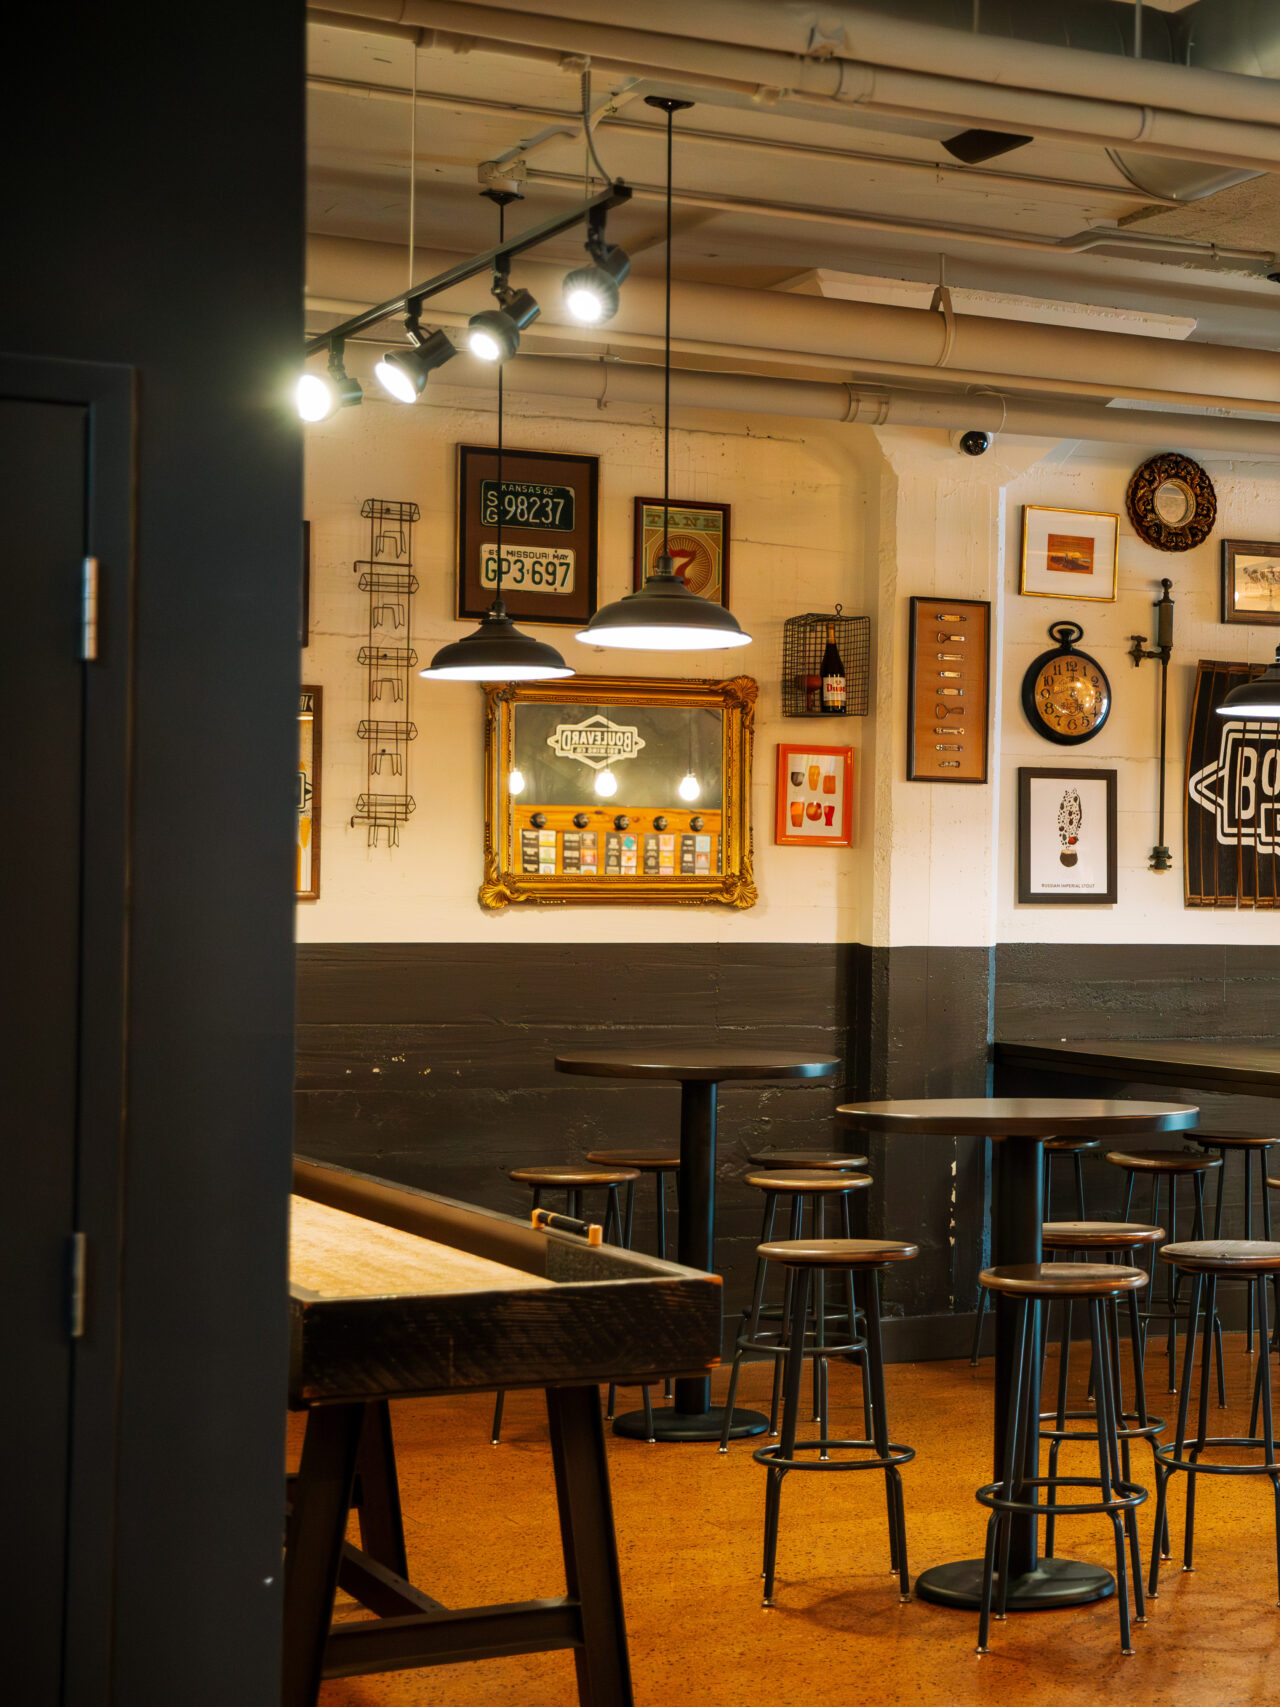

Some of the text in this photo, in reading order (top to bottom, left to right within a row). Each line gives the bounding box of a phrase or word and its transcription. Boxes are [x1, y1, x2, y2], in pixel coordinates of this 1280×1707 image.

[501, 484, 553, 496] KANSAS 62
[504, 495, 564, 525] 98237
[506, 549, 550, 560] MISSOURI
[1053, 664, 1062, 675] 11
[1065, 661, 1078, 672] 12
[1043, 674, 1054, 687] 10
[1090, 675, 1100, 688] 2
[1044, 702, 1054, 715] 8
[1054, 715, 1062, 726] 7
[1067, 719, 1078, 730] 6
[1081, 715, 1090, 728] 5
